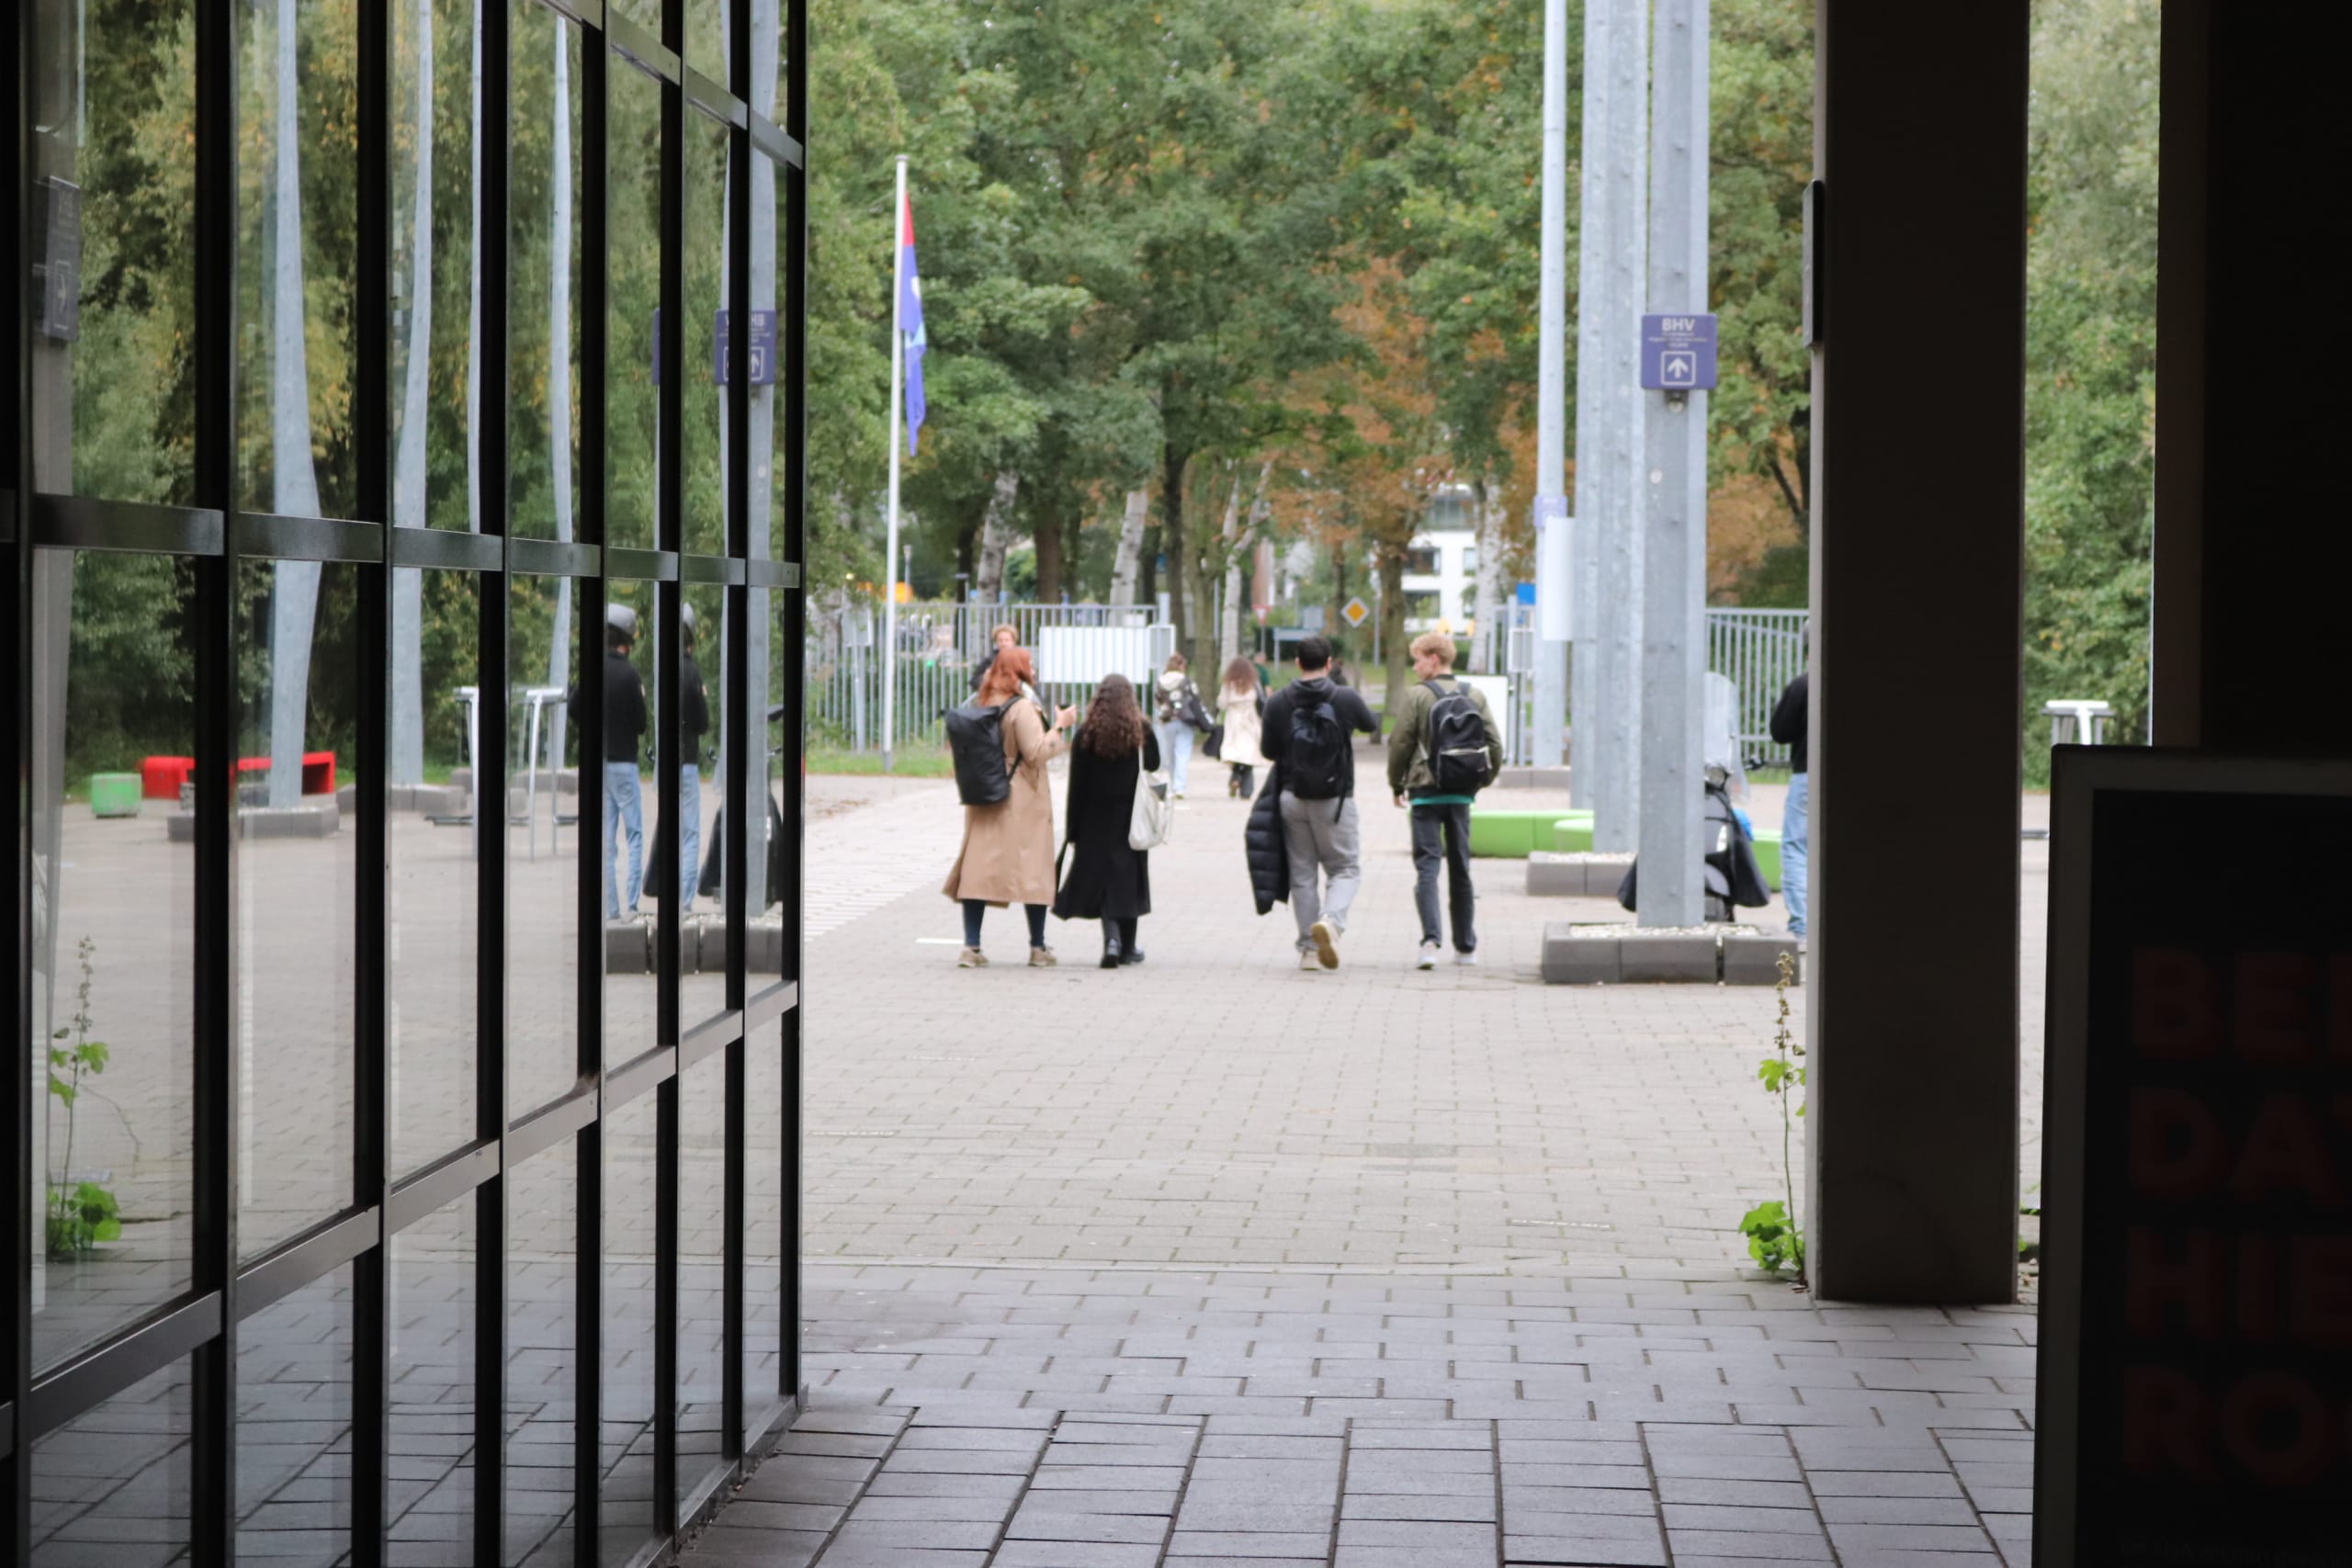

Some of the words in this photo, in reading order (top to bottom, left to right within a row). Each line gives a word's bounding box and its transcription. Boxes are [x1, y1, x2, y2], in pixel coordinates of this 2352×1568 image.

[1662, 318, 1695, 331] BHV
[2132, 947, 2352, 1066] BE
[2128, 1087, 2352, 1205] DA
[2122, 1365, 2352, 1486] RO
